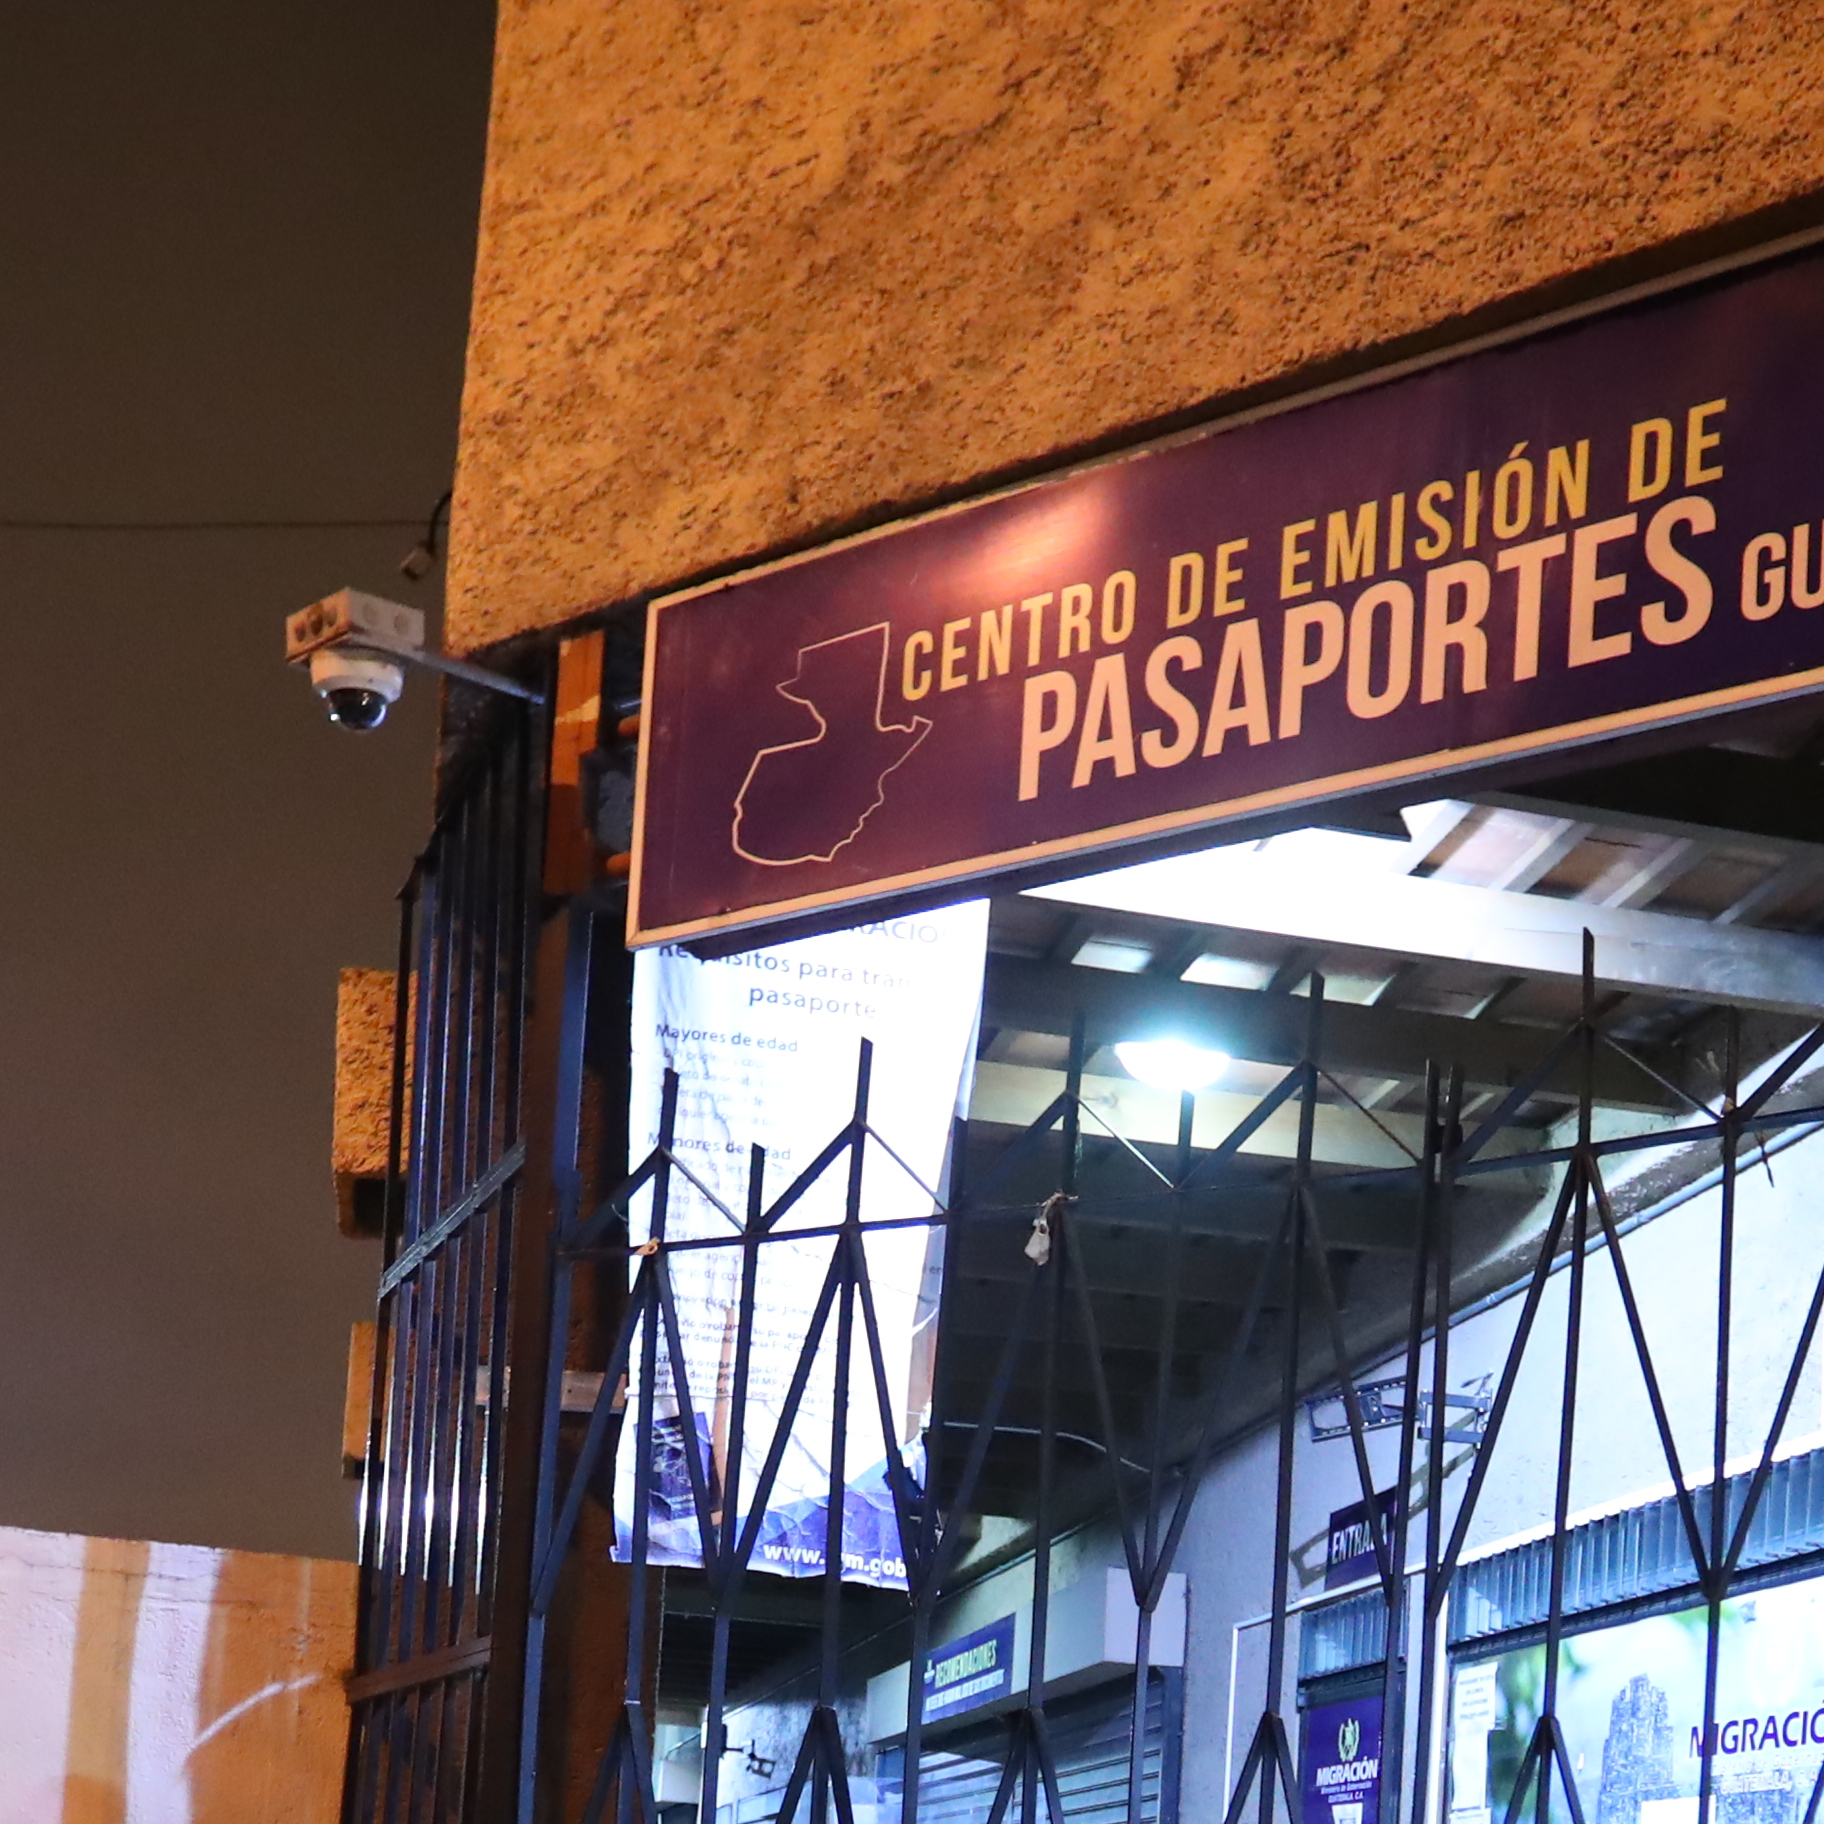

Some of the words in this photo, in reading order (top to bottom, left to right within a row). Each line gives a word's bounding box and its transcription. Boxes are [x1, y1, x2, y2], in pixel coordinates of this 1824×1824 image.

[899, 567, 1136, 702] CENTRO
[1167, 537, 1247, 631] DE
[1280, 438, 1591, 602] EMISIÓN
[1628, 398, 1728, 504] DE
[1017, 495, 1718, 803] PASAPORTES
[655, 1023, 727, 1045] Mayores
[731, 1031, 752, 1046] de
[756, 1036, 799, 1053] edad
[647, 1133, 721, 1154] Mnores
[1316, 1756, 1379, 1787] MIGRACIÓN
